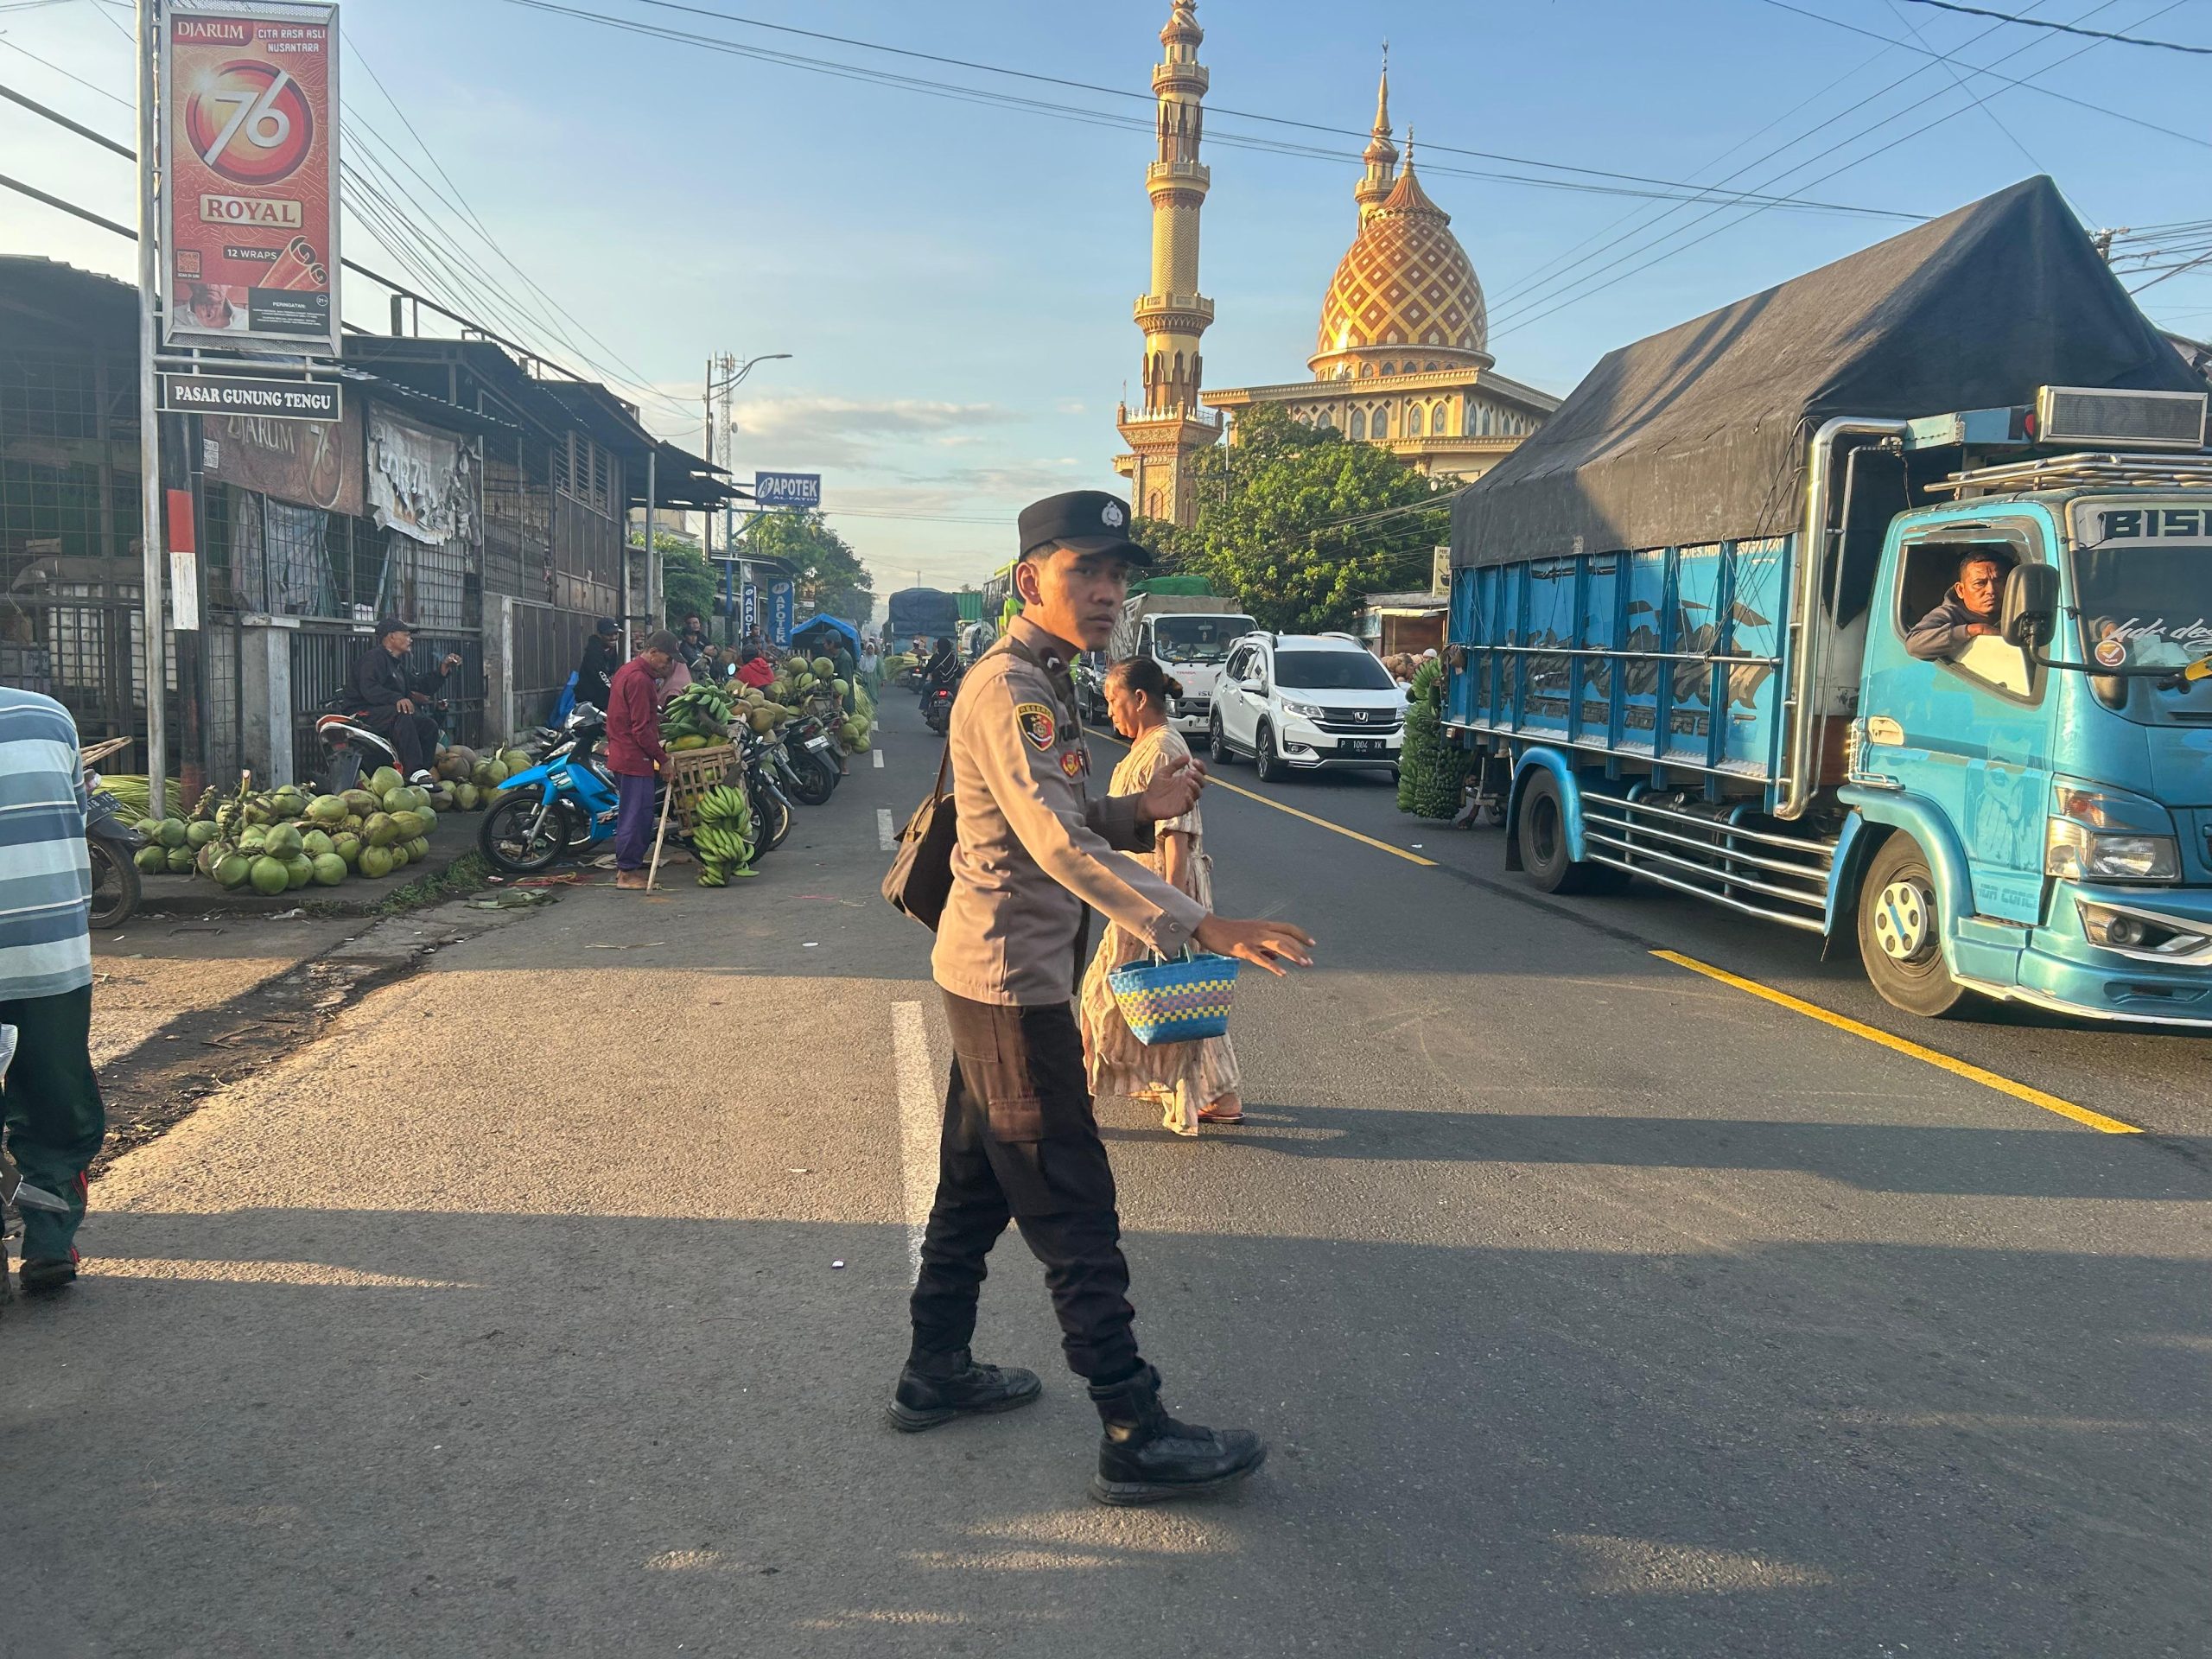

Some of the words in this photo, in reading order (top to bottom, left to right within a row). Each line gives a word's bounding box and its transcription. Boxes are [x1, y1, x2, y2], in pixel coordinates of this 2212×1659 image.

[178, 22, 244, 39] DJARUM
[258, 29, 280, 39] CITA
[281, 29, 304, 39] RASA
[306, 29, 325, 39] ASLI
[268, 43, 319, 53] NUSANTARA
[203, 69, 290, 167] 76
[207, 198, 296, 223] ROYAL
[227, 249, 238, 257] 12
[240, 250, 277, 260] WRAPS
[175, 385, 220, 404] PASAR
[223, 389, 283, 407] GUNUNG
[283, 392, 331, 410] TENGU
[772, 478, 817, 498] APOTEK
[776, 595, 786, 643] APOTEK
[1340, 740, 1345, 748] P
[1374, 741, 1382, 749] XK
